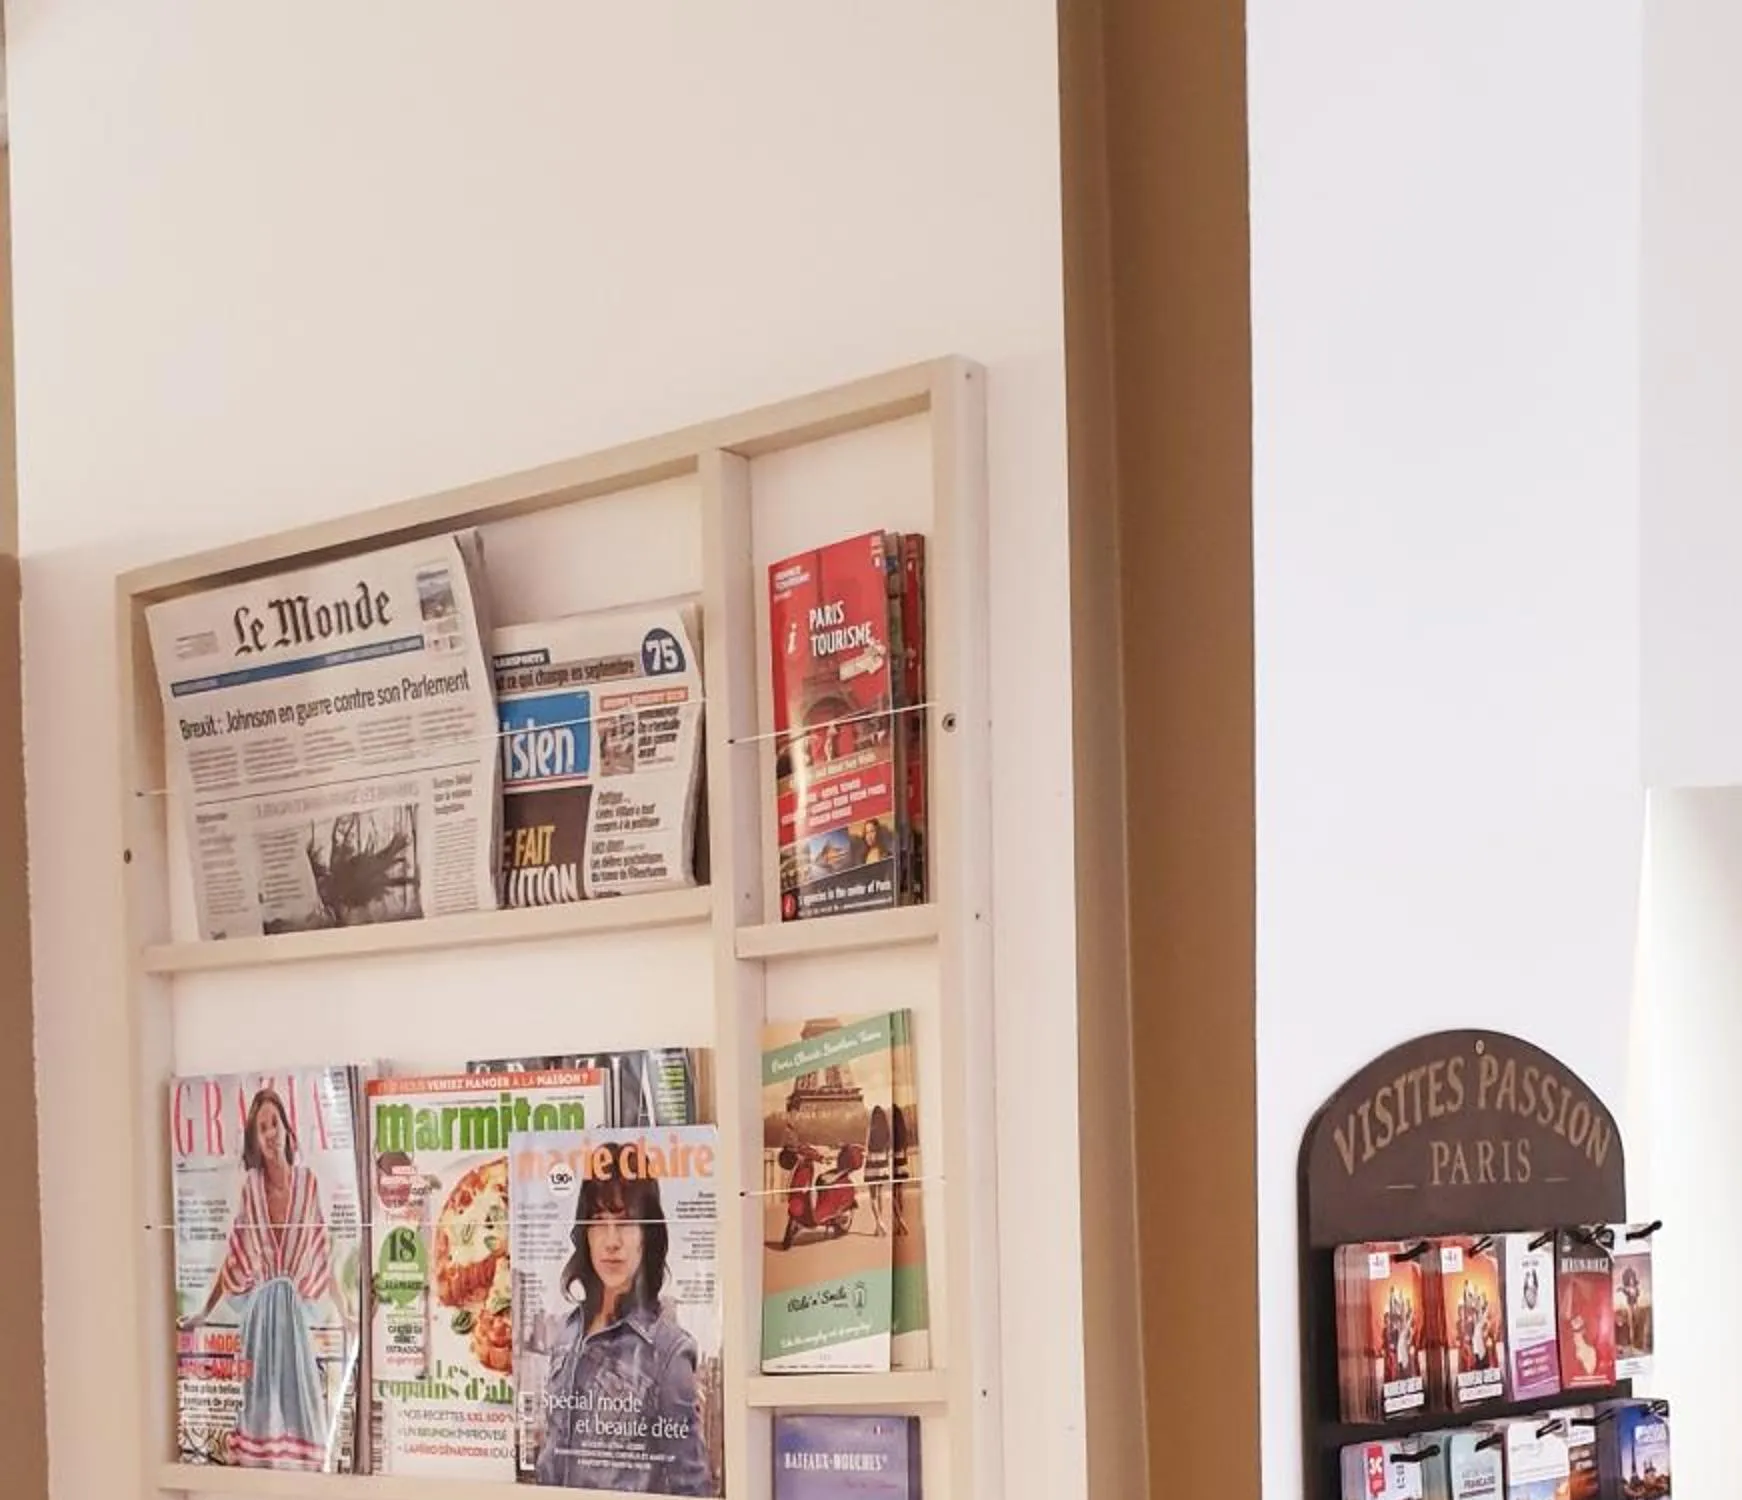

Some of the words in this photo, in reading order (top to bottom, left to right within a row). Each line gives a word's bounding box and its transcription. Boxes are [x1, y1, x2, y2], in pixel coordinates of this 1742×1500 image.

[232, 605, 266, 657] Le
[269, 580, 393, 648] Monde
[809, 600, 844, 631] PARIS
[645, 637, 681, 672] 75
[811, 621, 873, 657] TOURISME
[226, 705, 277, 735] Johnson
[278, 705, 295, 722] en
[296, 697, 332, 728] guerre
[334, 688, 375, 715] contre
[377, 683, 400, 707] son
[401, 667, 471, 701] Parlement
[376, 1093, 585, 1153] marmiton
[1333, 1054, 1465, 1177] VISITES
[1477, 1054, 1612, 1169] PASSION
[516, 1137, 614, 1185] marie
[618, 1133, 715, 1182] claire
[1429, 1138, 1532, 1187] PARIS
[390, 1228, 417, 1263] 18
[540, 1389, 594, 1415] Spécial
[598, 1391, 643, 1414] mode
[575, 1417, 590, 1433] et
[595, 1414, 648, 1439] beauté
[651, 1416, 690, 1440] d'été
